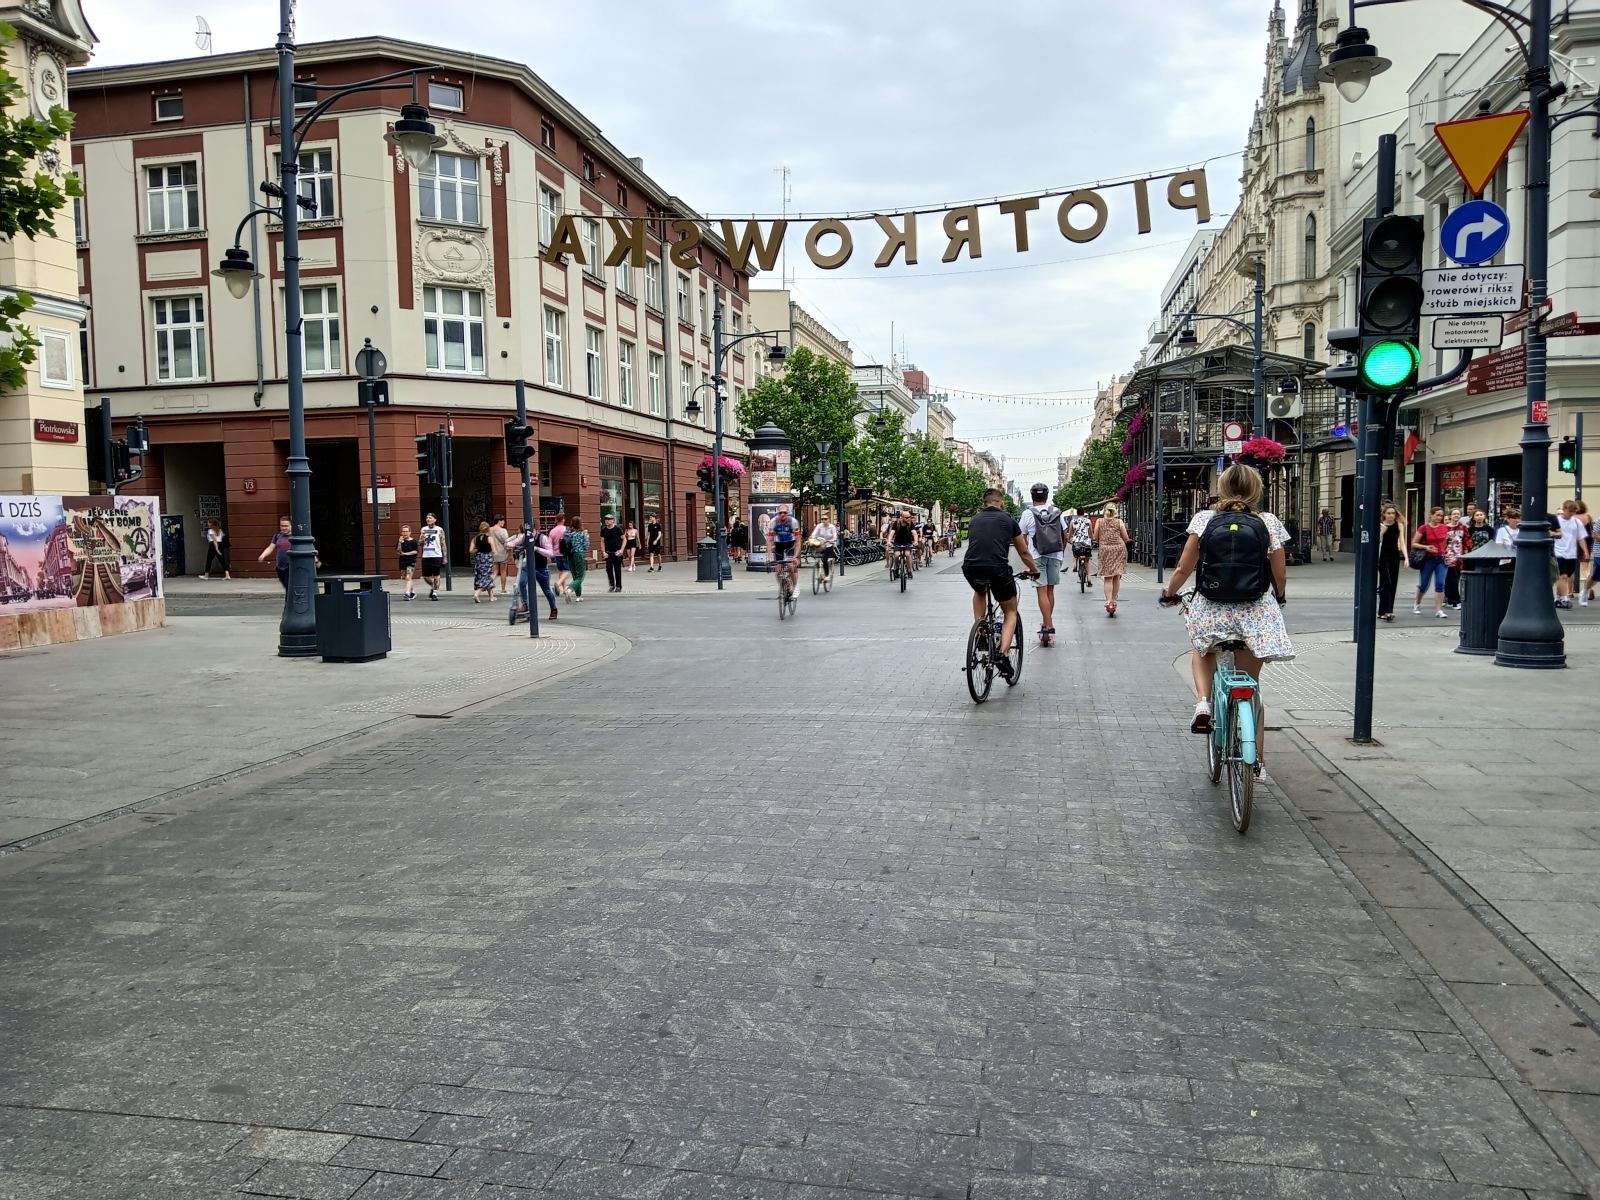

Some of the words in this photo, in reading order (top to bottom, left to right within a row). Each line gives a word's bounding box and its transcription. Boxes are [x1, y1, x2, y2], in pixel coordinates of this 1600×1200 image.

[1438, 273, 1457, 282] Nie
[1461, 272, 1508, 282] dotyczy:
[1487, 284, 1513, 293] riksz
[1463, 296, 1516, 308] miejskich
[40, 423, 75, 435] Piotrkowska
[9, 497, 42, 518] DZIŚ
[116, 516, 142, 527] BOMB
